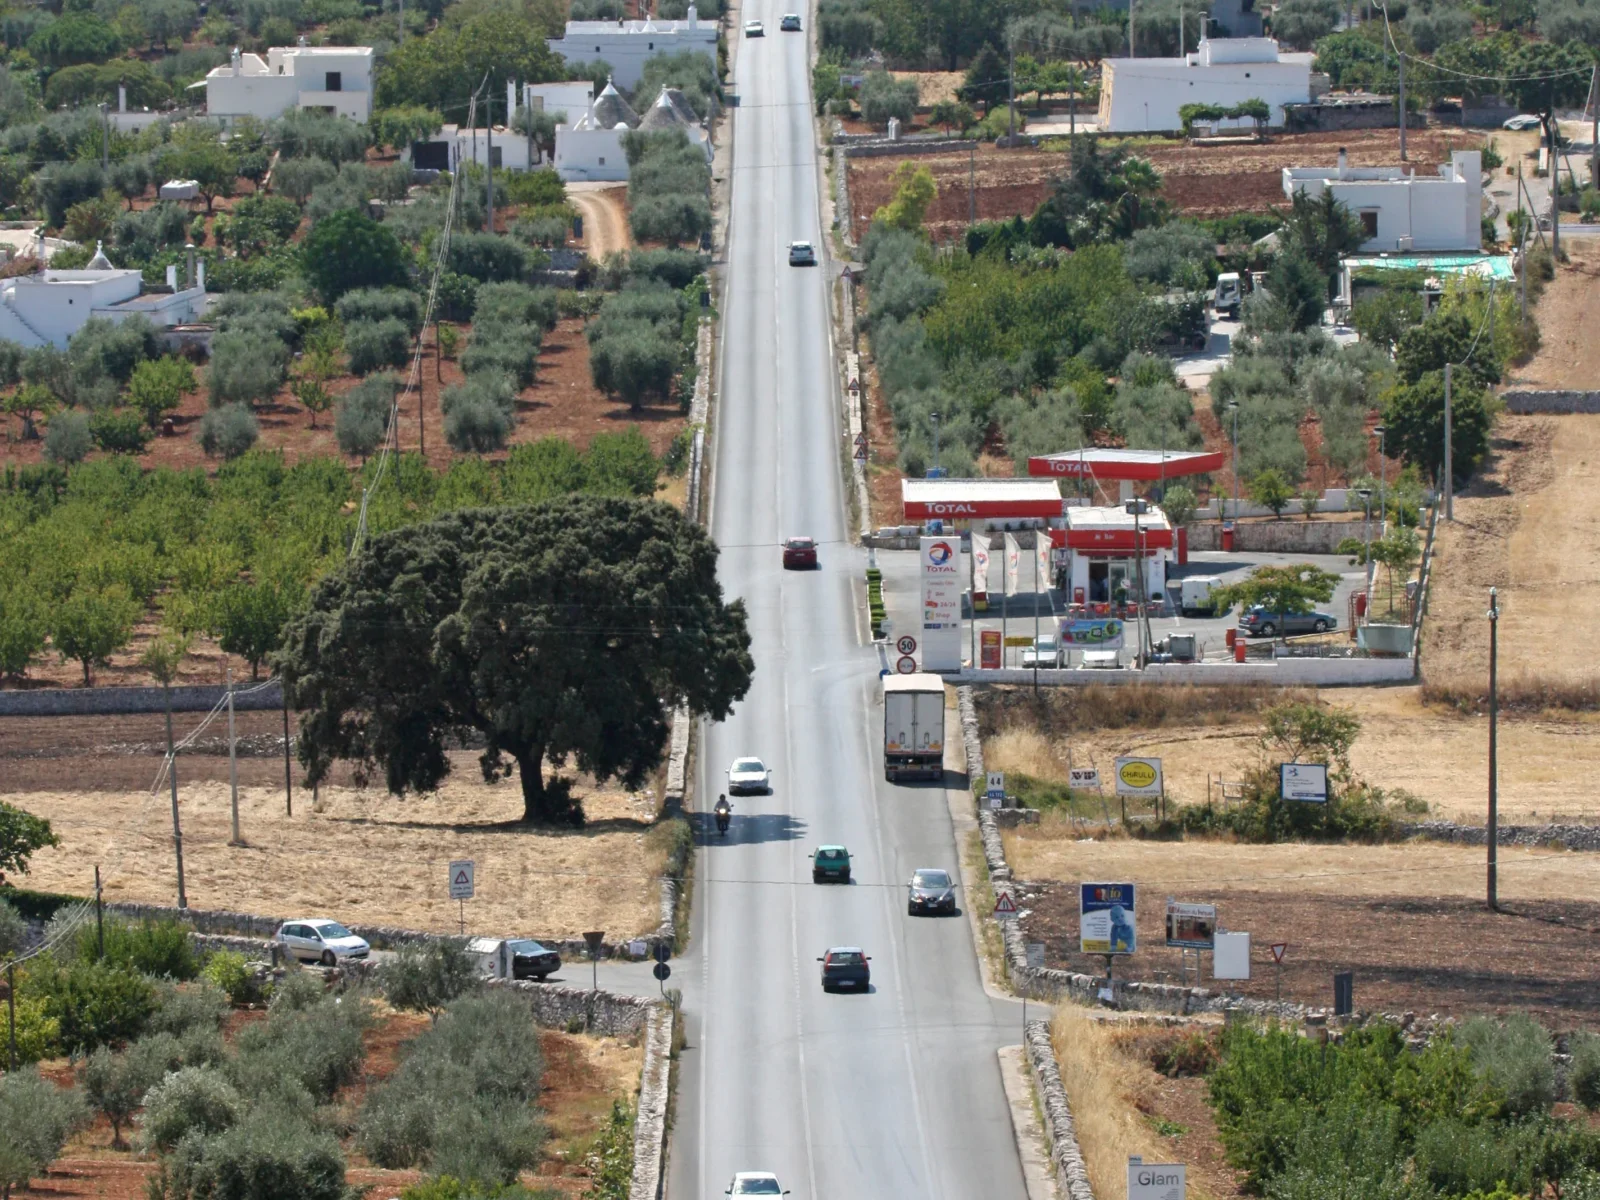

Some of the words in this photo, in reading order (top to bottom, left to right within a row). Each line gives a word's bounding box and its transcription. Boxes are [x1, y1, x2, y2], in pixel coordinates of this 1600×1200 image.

[1048, 460, 1091, 473] TOTAL
[924, 502, 977, 513] TOTAL
[901, 640, 912, 650] 50
[1138, 1171, 1179, 1186] Glam
